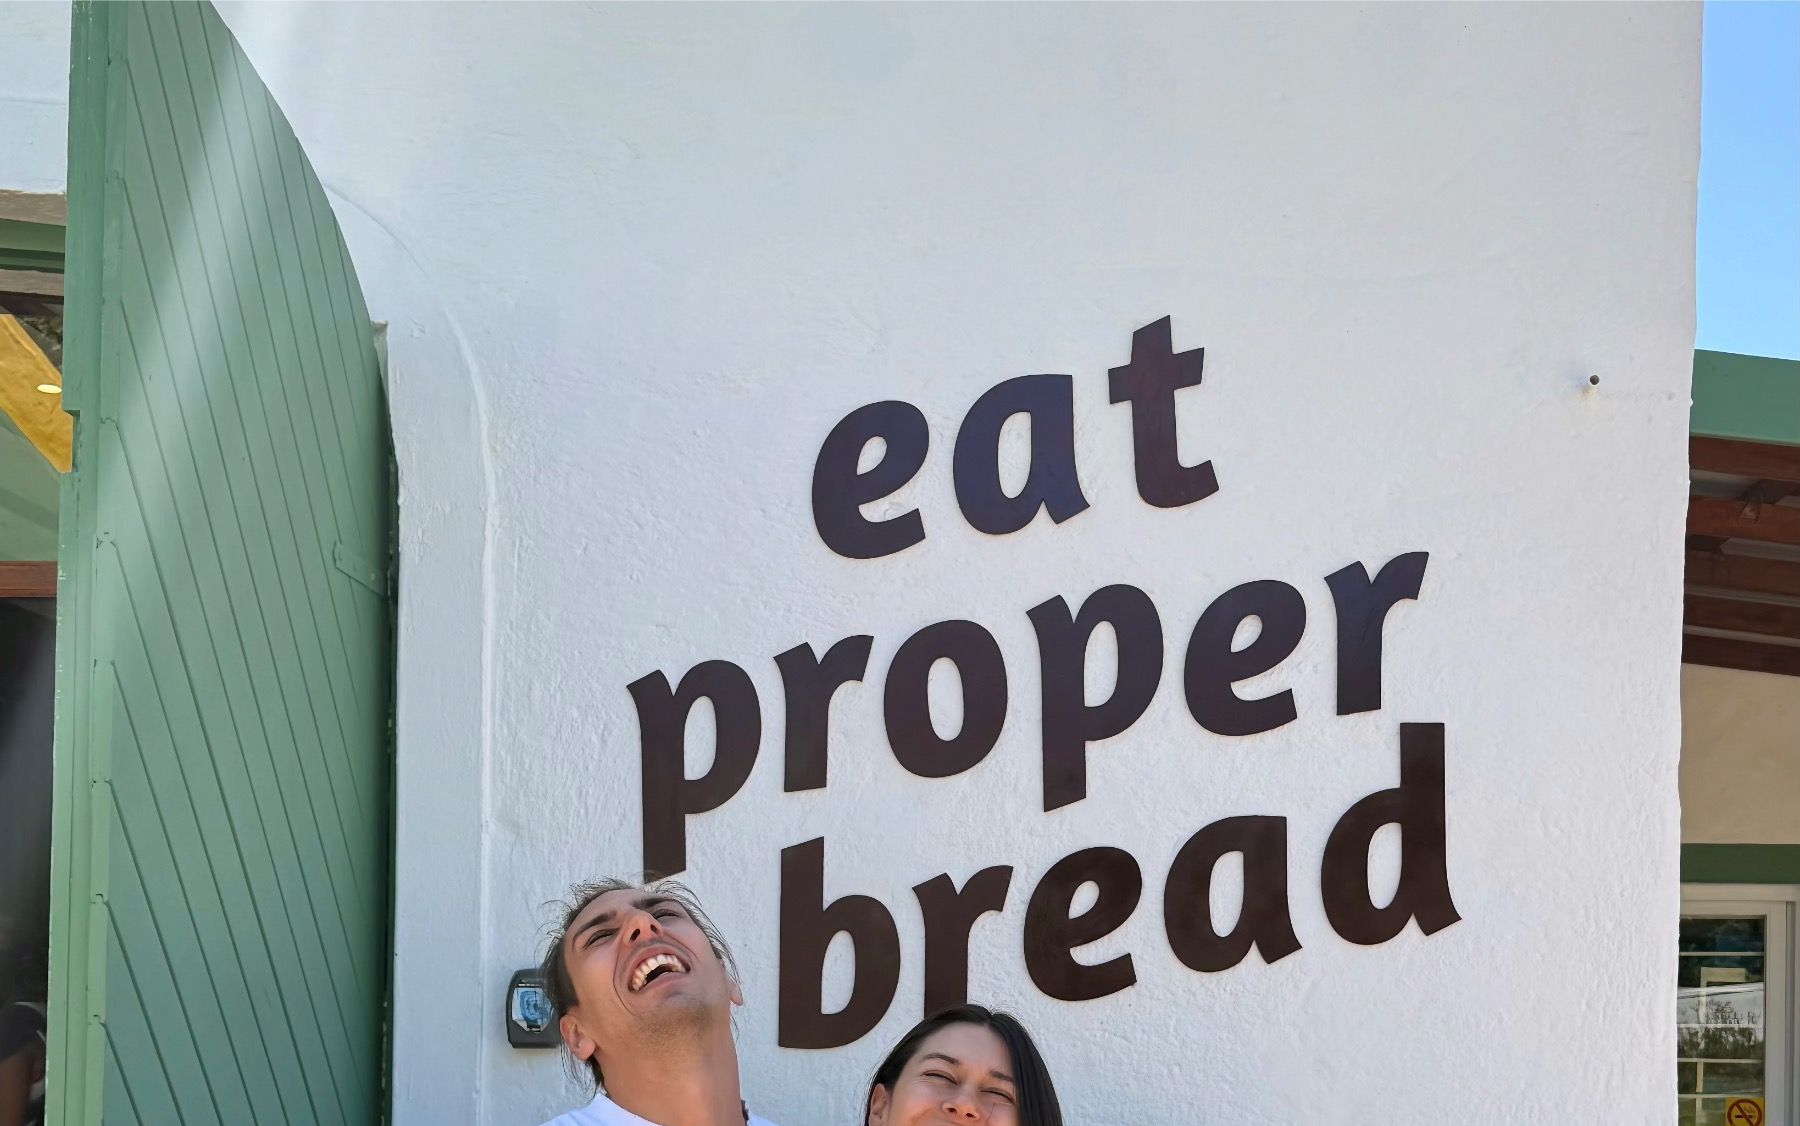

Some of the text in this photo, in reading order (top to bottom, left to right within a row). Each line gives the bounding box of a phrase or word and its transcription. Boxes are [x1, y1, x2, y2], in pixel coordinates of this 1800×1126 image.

[811, 314, 1220, 560] eat
[626, 551, 1430, 885] proper
[778, 722, 1463, 1050] bread
